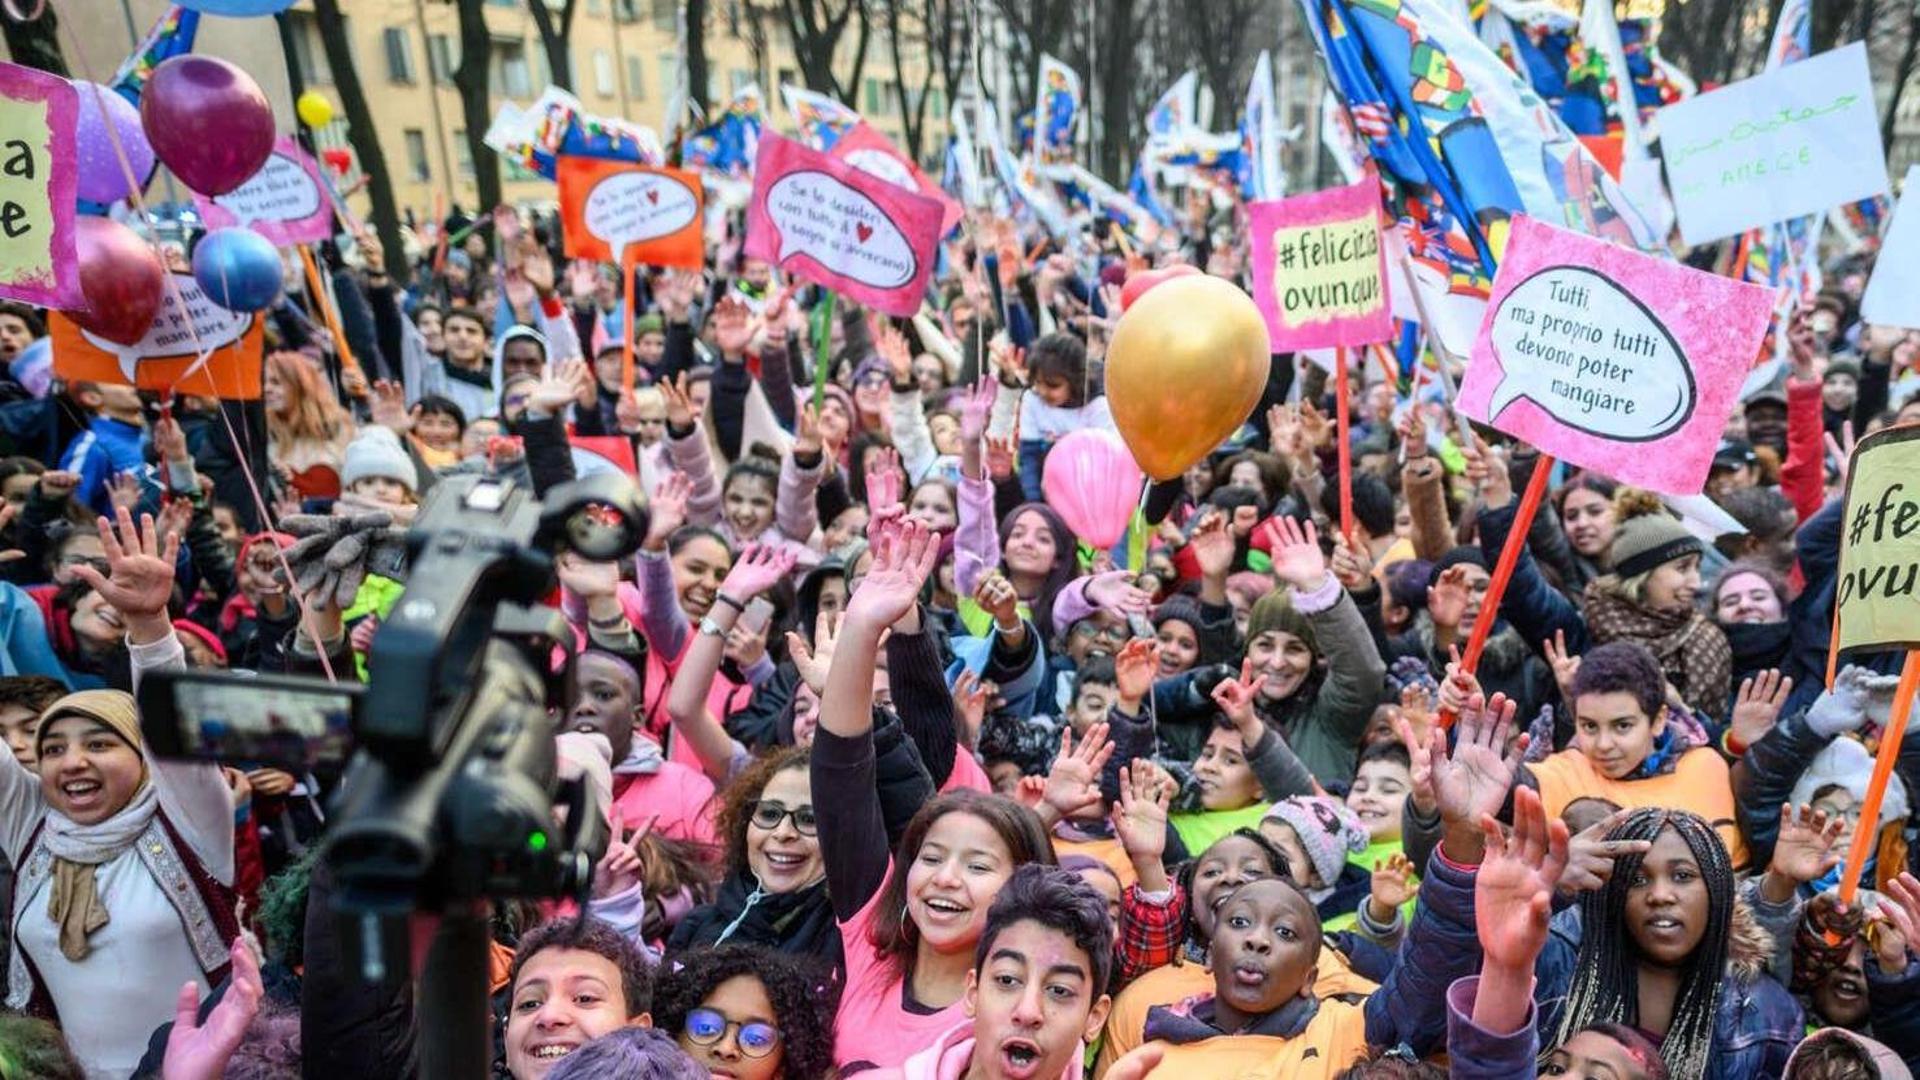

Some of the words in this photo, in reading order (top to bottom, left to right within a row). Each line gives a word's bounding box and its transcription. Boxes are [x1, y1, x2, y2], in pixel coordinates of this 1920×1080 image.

[1550, 280, 1591, 311] Tutti,
[155, 321, 226, 348] manare
[1511, 306, 1535, 325] ma
[1541, 314, 1603, 344] proprio
[1614, 328, 1658, 358] tutti
[1516, 332, 1574, 367] devono
[1576, 355, 1633, 383] poter
[1551, 378, 1636, 414] mangiare
[1849, 484, 1920, 547] #fe
